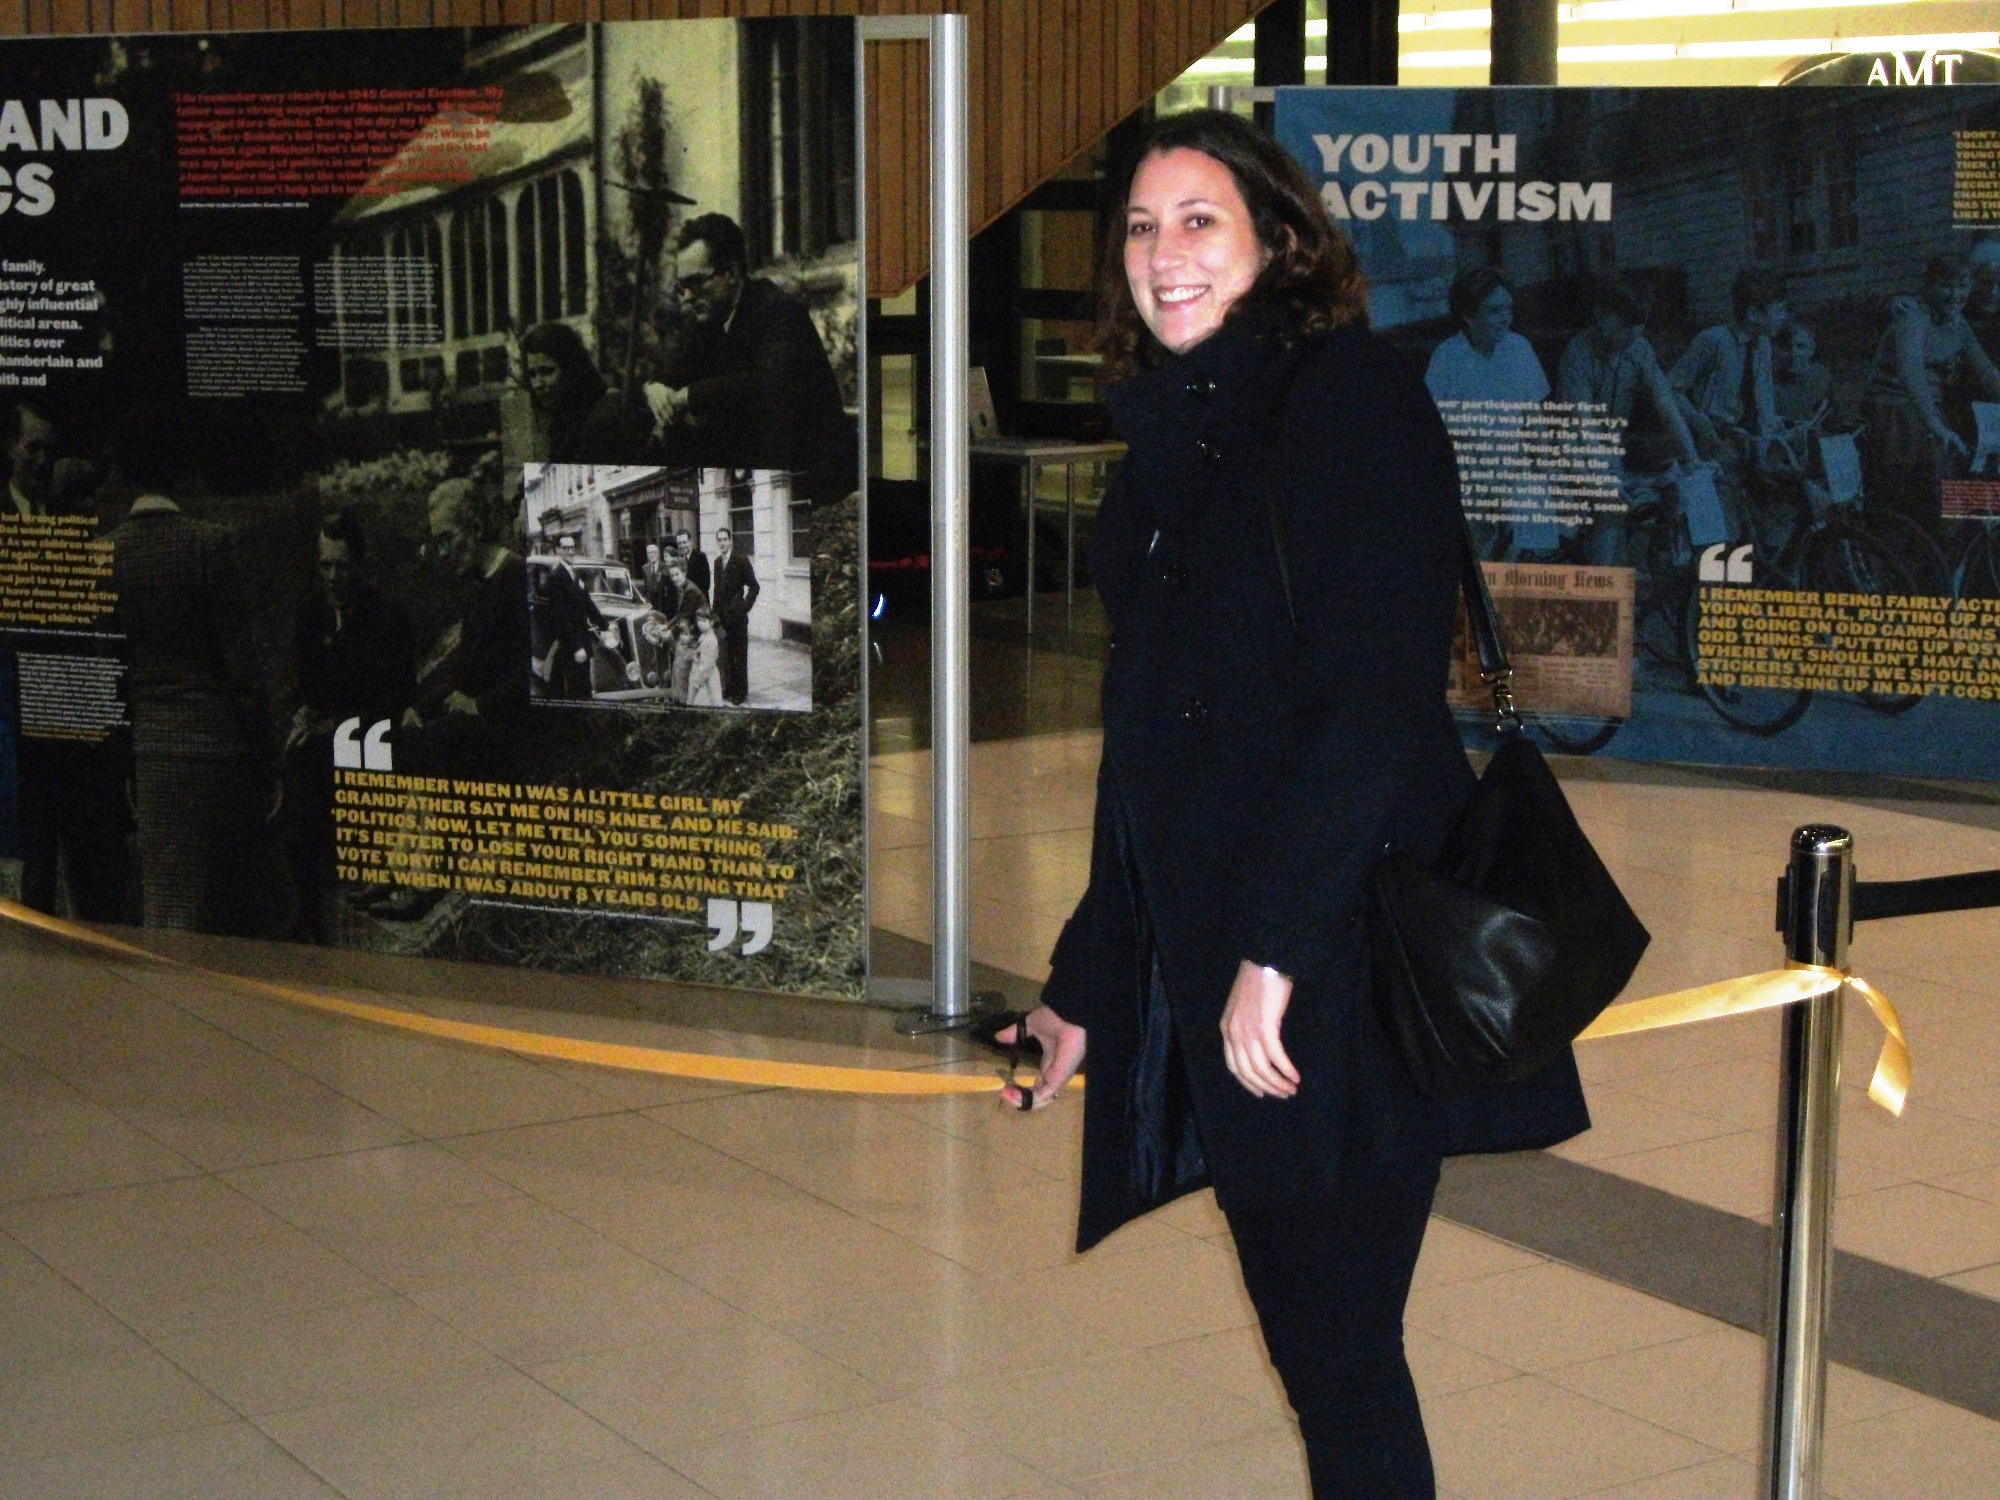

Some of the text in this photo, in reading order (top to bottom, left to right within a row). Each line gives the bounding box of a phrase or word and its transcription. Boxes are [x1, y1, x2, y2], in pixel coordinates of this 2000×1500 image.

[1867, 50, 1963, 86] AMT
[0, 98, 129, 152] AND
[1312, 133, 1517, 174] YOUTH
[1956, 151, 1995, 159] YOUNG
[1319, 180, 1613, 222] ACTIVISM
[2, 259, 46, 276] family.
[40, 278, 55, 292] of
[55, 279, 96, 296] great
[27, 297, 99, 311] influential
[38, 319, 83, 330] arena.
[33, 338, 65, 349] over
[76, 355, 103, 368] and
[21, 373, 47, 387] and
[1462, 399, 1541, 415] participants
[1543, 401, 1575, 412] their
[1577, 401, 1608, 413] first
[1447, 413, 1496, 425] activity
[1498, 415, 1525, 425] was
[1525, 415, 1570, 427] joining
[1571, 417, 1579, 426] a
[1581, 417, 1629, 430] party's
[1479, 428, 1620, 444] branches of the Young
[1496, 443, 1519, 453] and
[1522, 443, 1561, 456] Young
[1562, 443, 1626, 455] Socialists
[1479, 456, 1609, 470] cut their teeth in the
[1471, 470, 1622, 484] and election campaigns.
[1476, 484, 1619, 498] to mix with likeminded
[1476, 498, 1629, 513] and ideals. Indeed, some
[1485, 513, 1594, 527] spouse through a
[1505, 569, 1614, 590] Morning News
[1700, 587, 1706, 599] I
[1710, 587, 1821, 604] REMEMBER
[1824, 592, 1883, 607] BEING
[1886, 594, 1952, 610] FAIRLY
[1699, 601, 1763, 617] YOUNG
[1767, 604, 1854, 622] LIBERAL,
[1858, 608, 1946, 625] PUTTING
[1950, 612, 1977, 626] UP
[1698, 616, 1997, 641] AND GOING ON ODD CAMPAIGNS
[1698, 629, 1739, 643] ODD
[1831, 635, 1918, 652] PUTTING
[1922, 639, 1949, 654] UP
[1698, 644, 1769, 659] WHERE
[1772, 647, 1804, 661] WE
[1807, 649, 1918, 667] SHOULDN'T
[1922, 654, 1974, 669] HAVE
[1697, 658, 1795, 675] STICKERS
[1798, 662, 1870, 678] WHERE
[1874, 666, 1906, 680] WE
[1697, 672, 1736, 686] AND
[1740, 673, 1839, 691] DRESSING
[1843, 678, 1869, 692] UP
[1872, 680, 1893, 694] IN
[1896, 682, 1950, 697] DAFT
[334, 770, 744, 815] I REMEMBER WHEN I WAS A LITTLE GIRL MY
[335, 789, 799, 840] GRANDFATHER SAT ME ON HIS KNEE, AND HE SAID:
[424, 816, 472, 835] NOW,
[475, 820, 511, 836] LET
[516, 822, 546, 838] ME
[549, 825, 595, 844] TELL
[598, 829, 638, 847] YOU
[336, 827, 795, 880] IT'S BETTER TO LOSE YOUR RIGHT HAND THAN TO
[336, 846, 382, 864] VOTE
[447, 855, 454, 870] I
[457, 857, 496, 874] CAN
[499, 860, 610, 884] REMEMBER
[614, 870, 655, 887] HIM
[659, 873, 730, 895] SAYING
[733, 880, 788, 900] THAT
[336, 864, 359, 881] TO
[362, 868, 390, 884] ME
[393, 870, 451, 889] WHEN
[454, 875, 461, 890] I
[464, 876, 507, 894] WAS
[510, 880, 572, 901] ABOUT
[576, 886, 588, 903] 8
[591, 887, 657, 907] YEARS
[661, 893, 703, 912] OLD.
